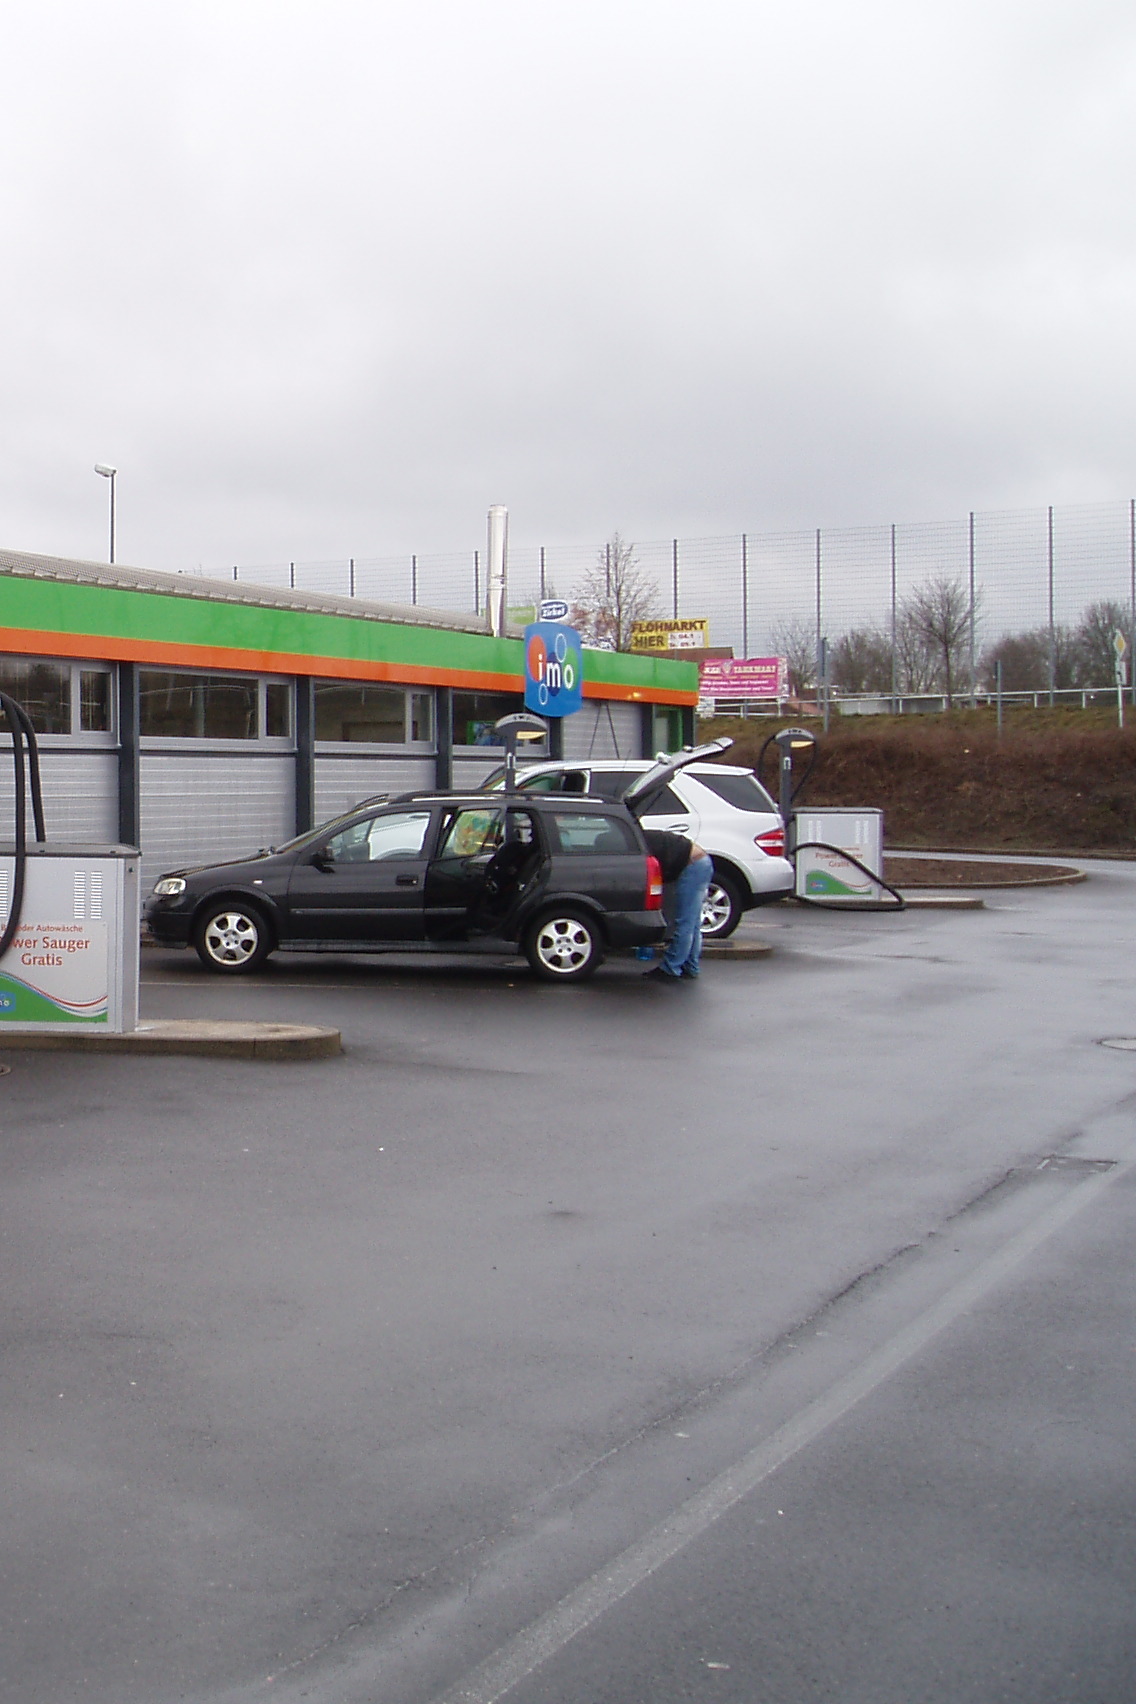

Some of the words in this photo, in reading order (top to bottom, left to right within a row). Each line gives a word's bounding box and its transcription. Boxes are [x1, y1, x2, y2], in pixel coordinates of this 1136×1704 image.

[631, 620, 706, 633] FLOHMARKT
[633, 635, 665, 647] HIER
[538, 653, 574, 690] imo
[36, 924, 83, 932] Autowäsche
[42, 936, 91, 952] Sauger
[21, 953, 63, 965] Gratis
